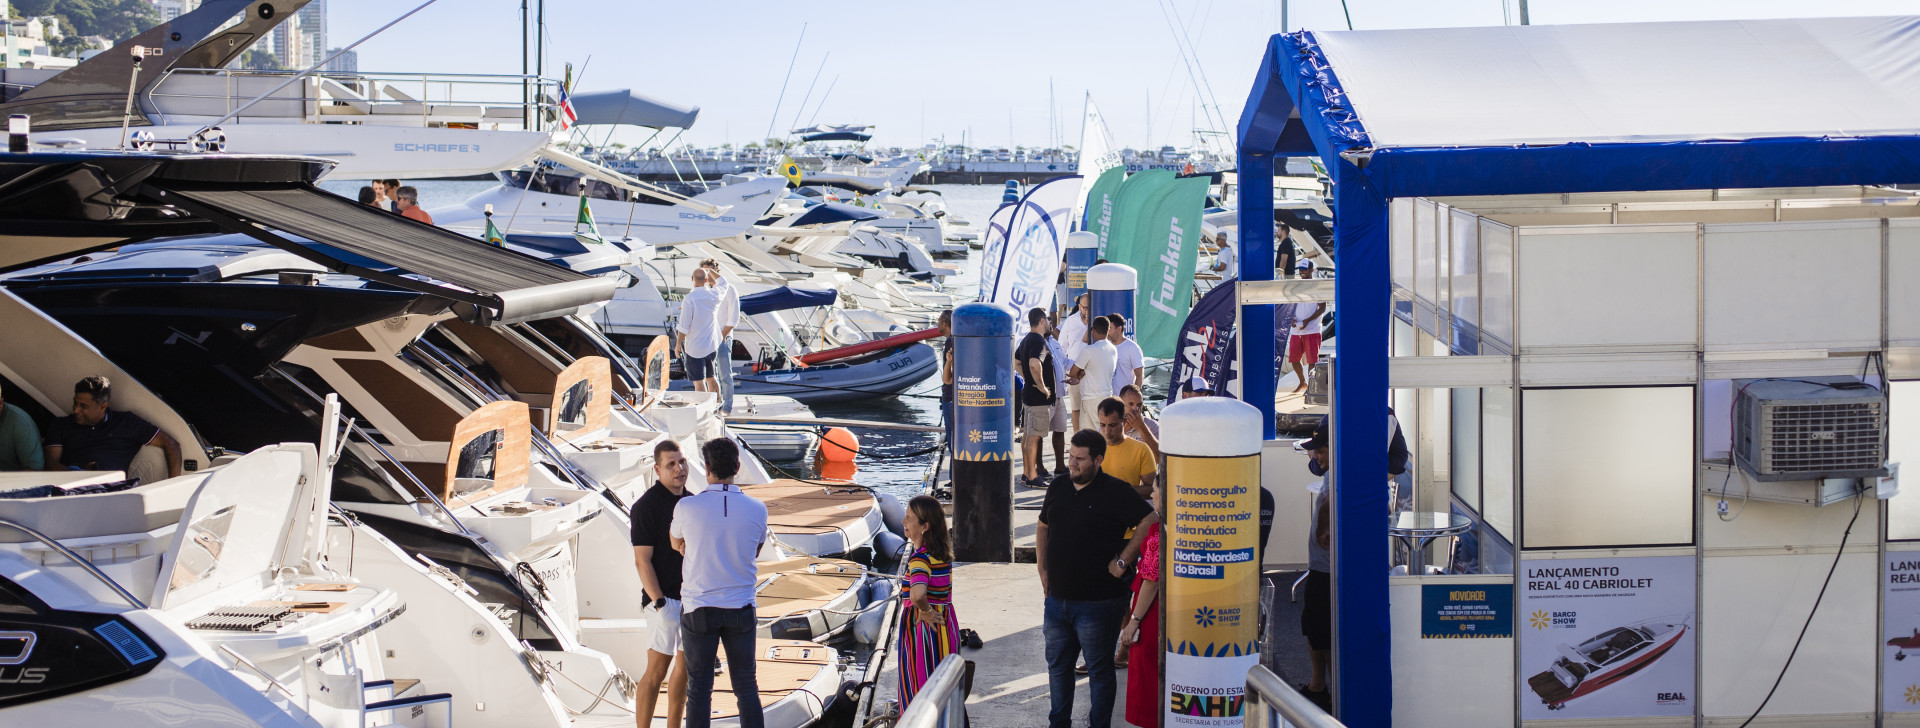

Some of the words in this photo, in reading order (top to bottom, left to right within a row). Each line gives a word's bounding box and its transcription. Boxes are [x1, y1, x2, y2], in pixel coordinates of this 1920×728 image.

[393, 143, 480, 153] SCHAEFER
[1175, 484, 1209, 495] Temos
[1210, 485, 1247, 498] orgulho
[1175, 498, 1187, 508] de
[1188, 500, 1227, 509] sermos
[1228, 500, 1235, 508] a
[1175, 511, 1218, 523] primeira
[1218, 514, 1226, 522] e
[1226, 510, 1252, 521] maior
[1175, 524, 1196, 535] feira
[1197, 525, 1237, 535] náutica
[1175, 537, 1188, 547] da
[1188, 538, 1222, 550] região
[1175, 564, 1187, 574] do
[1187, 565, 1217, 575] Brasil
[1528, 566, 1619, 580] LANÇAMENTO
[1528, 580, 1561, 591] REAL
[1564, 580, 1579, 590] 40
[1582, 578, 1653, 589] CABRIOLET
[1171, 684, 1210, 695] GOVERNO
[1226, 687, 1245, 695] ESTA
[1657, 692, 1686, 701] REAL
[1175, 716, 1211, 726] SECRETARIA
